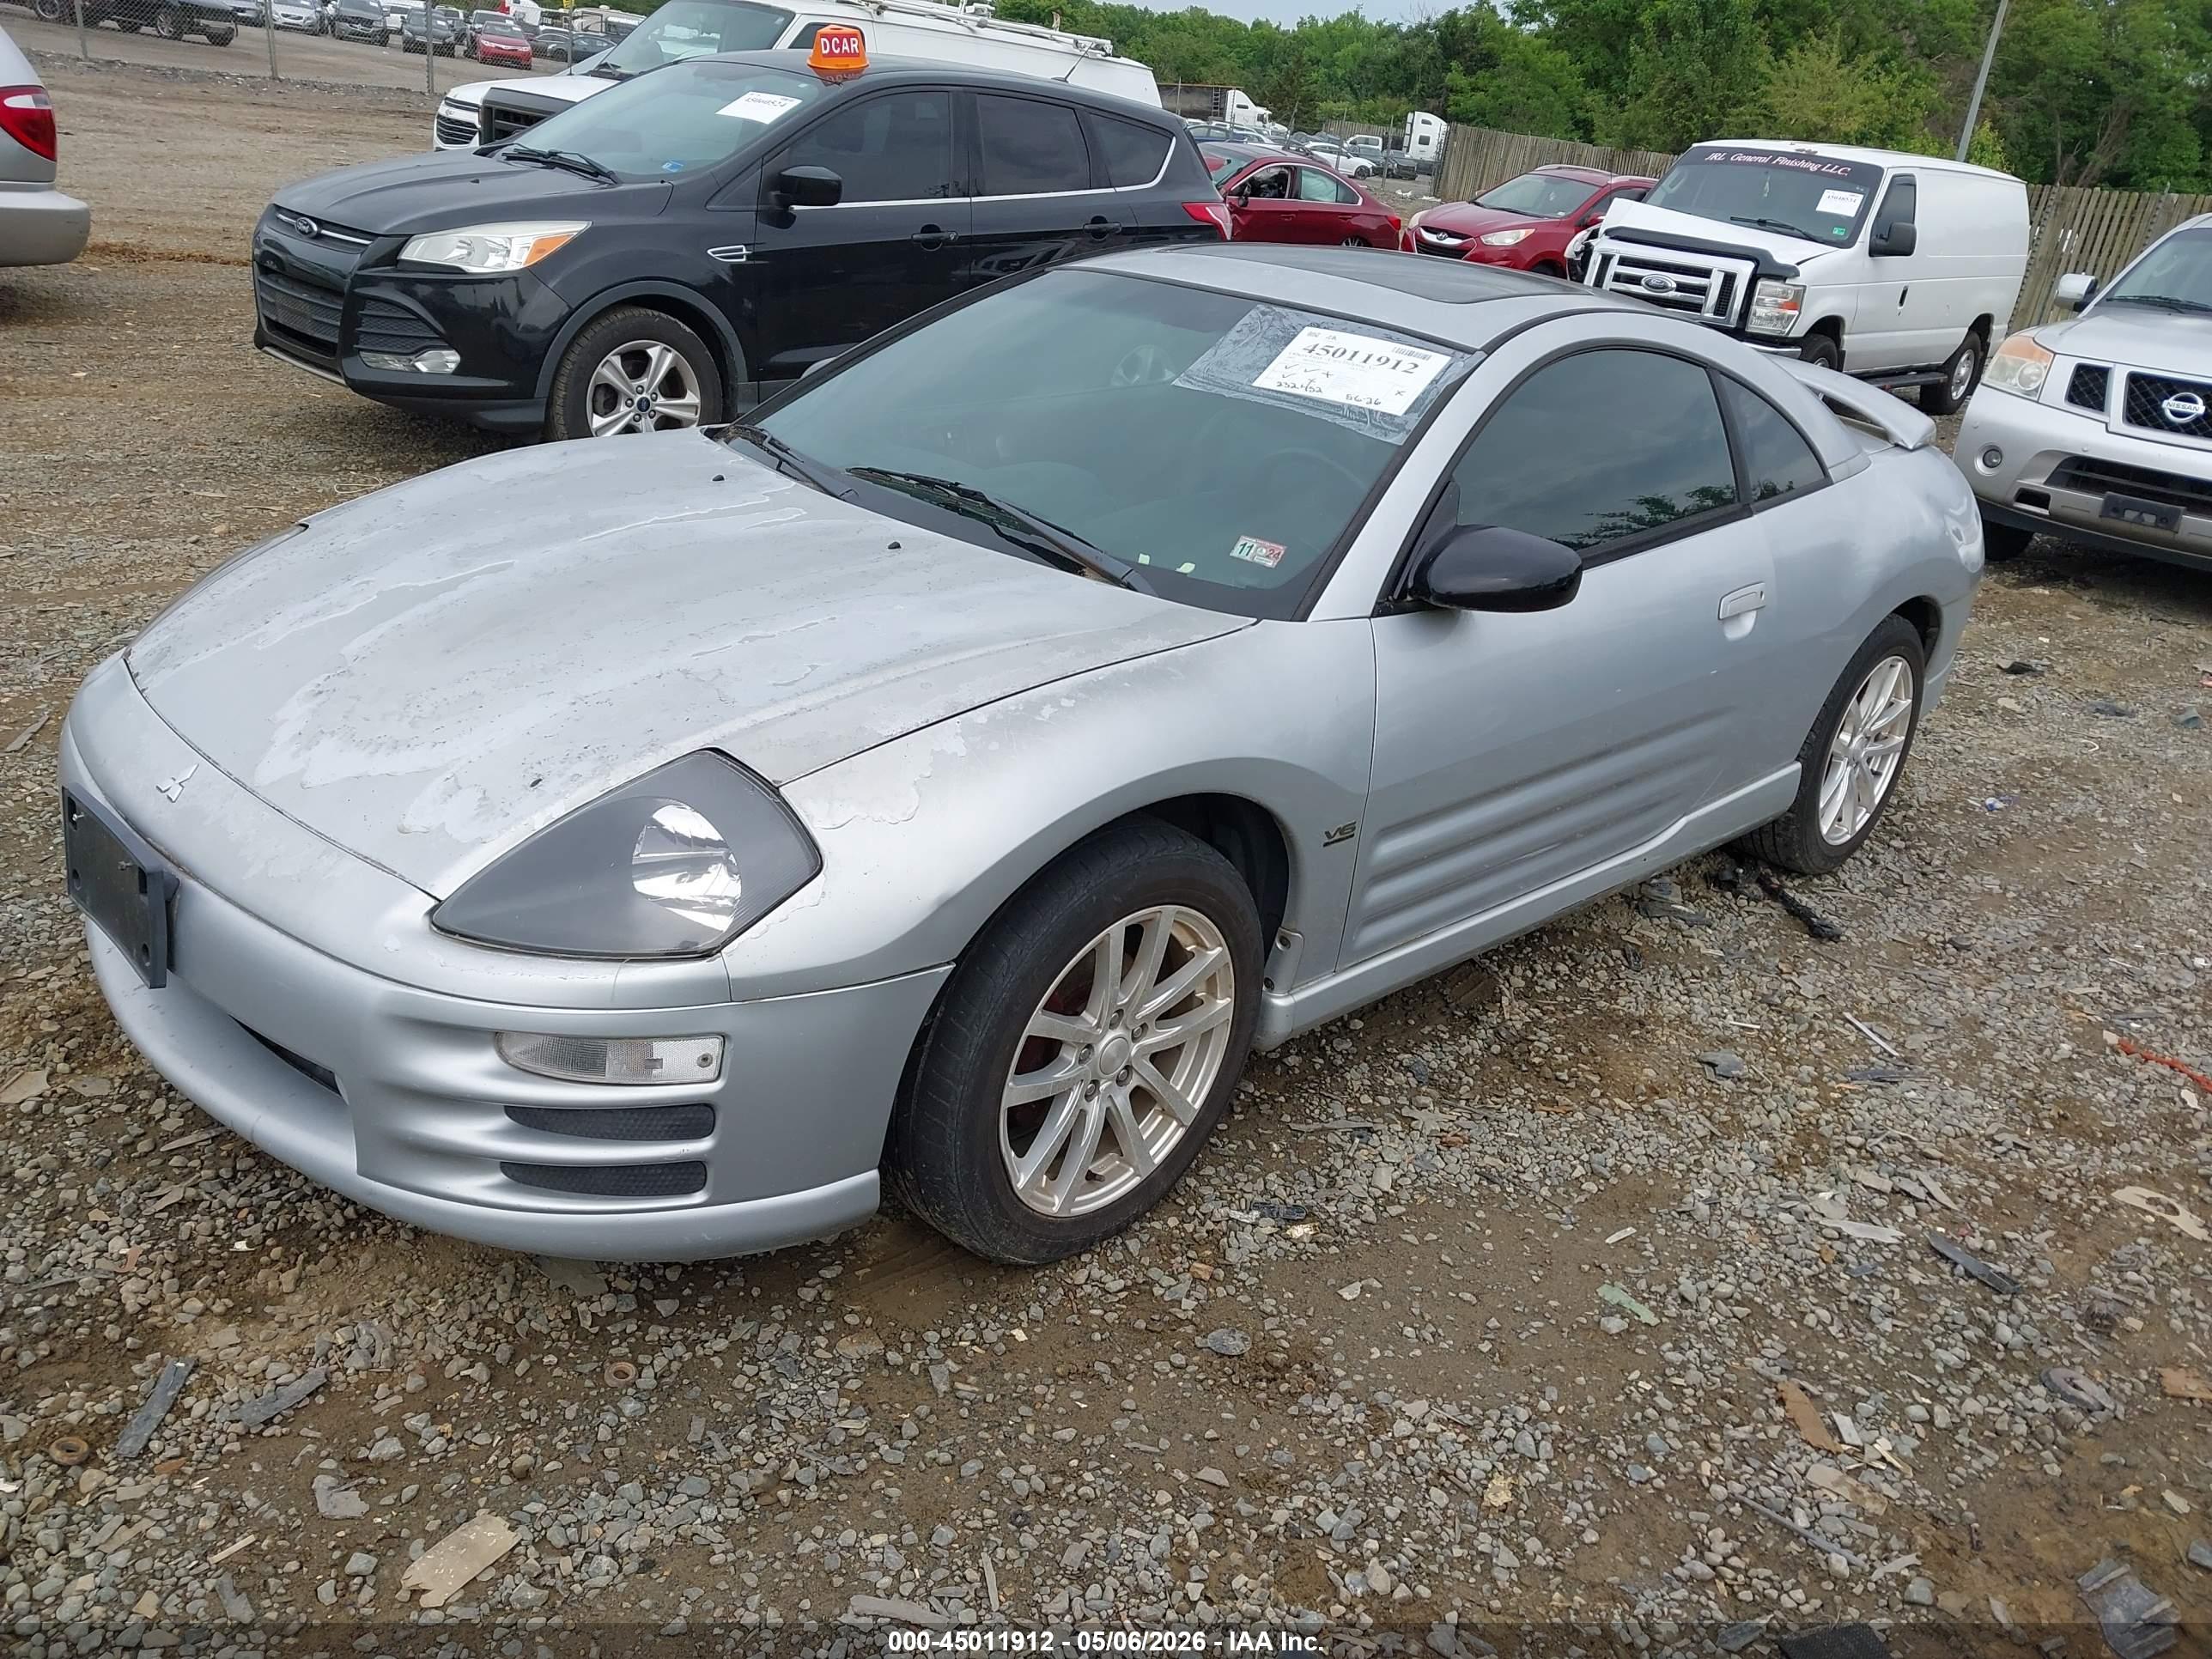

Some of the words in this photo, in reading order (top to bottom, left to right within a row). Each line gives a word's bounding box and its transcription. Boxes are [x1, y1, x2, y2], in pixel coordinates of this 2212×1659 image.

[820, 37, 860, 54] DCAR
[1705, 152, 1729, 161] JRL
[1730, 153, 1772, 164] General
[1771, 156, 1821, 171] Finishing
[1303, 343, 1419, 374] 45011912
[2166, 401, 2200, 411] NISSAN
[1238, 542, 1255, 556] 11
[1324, 821, 1357, 840] V6
